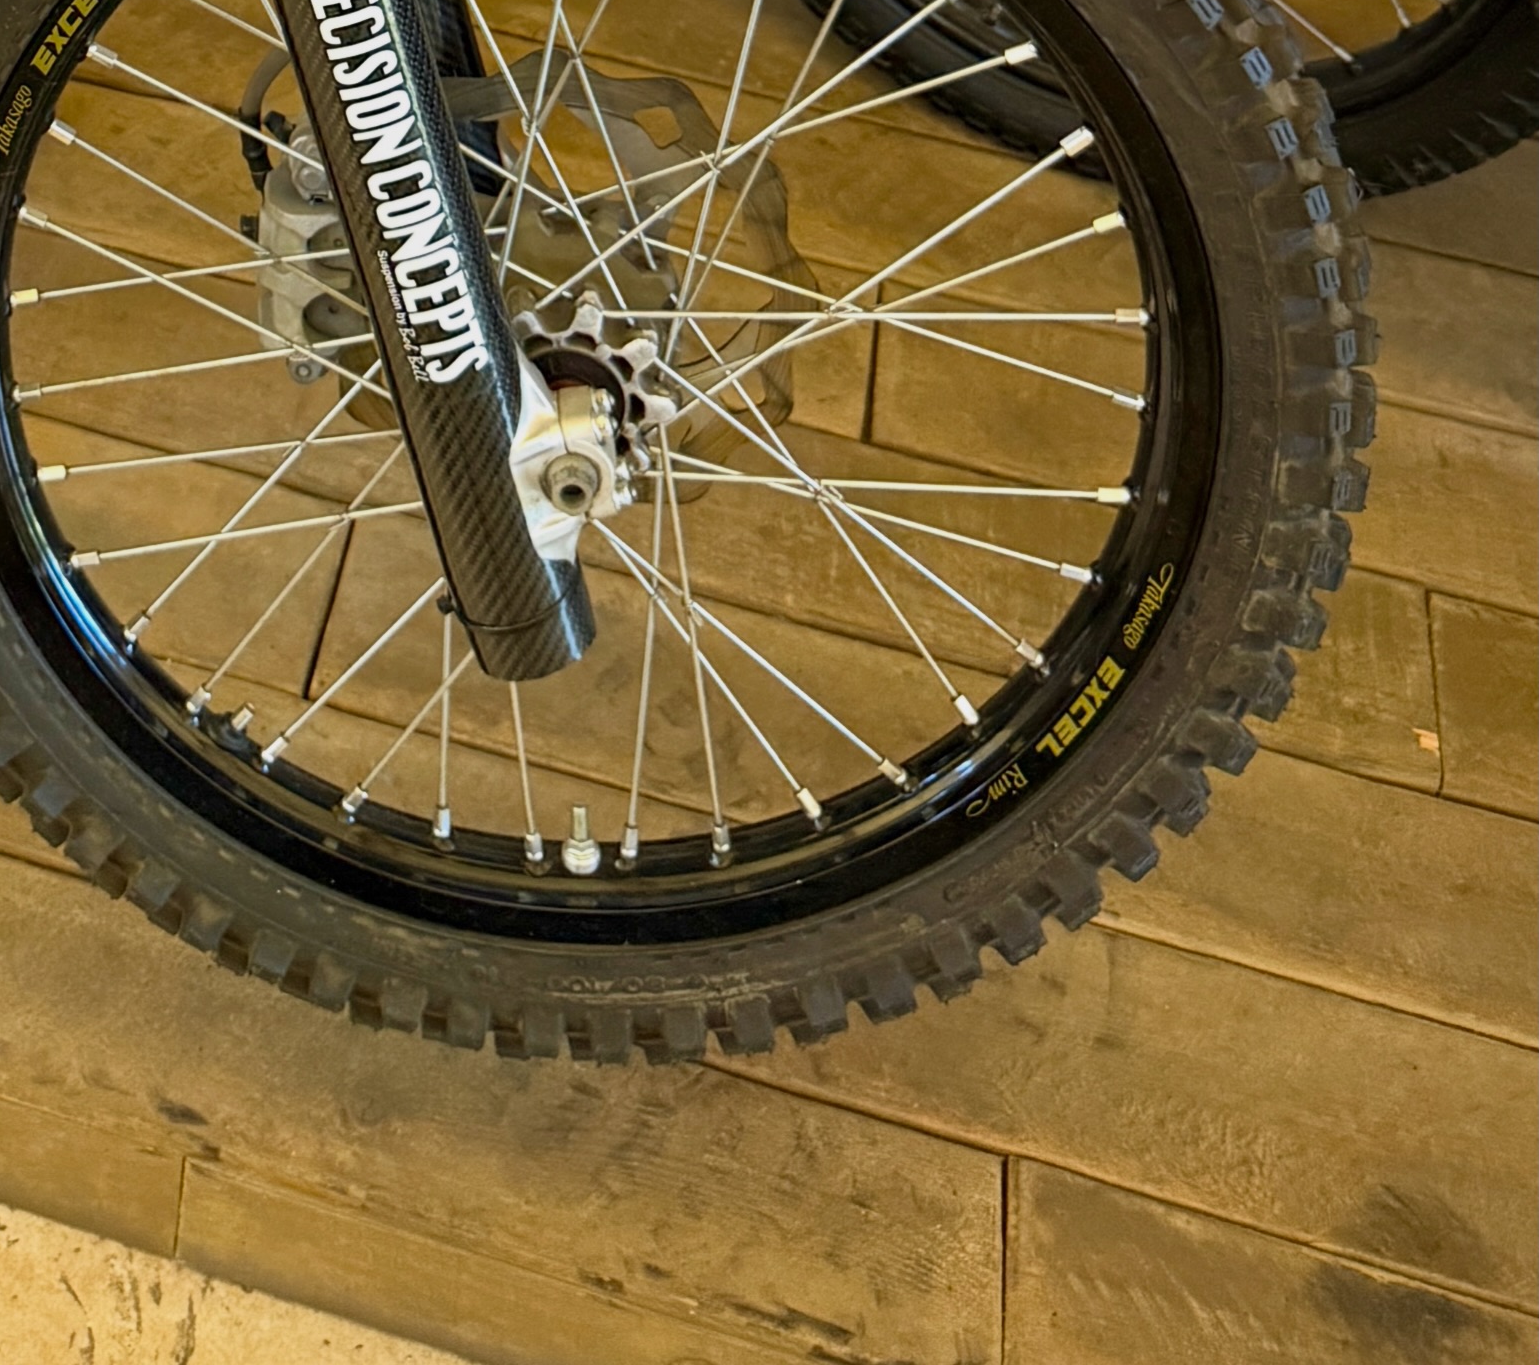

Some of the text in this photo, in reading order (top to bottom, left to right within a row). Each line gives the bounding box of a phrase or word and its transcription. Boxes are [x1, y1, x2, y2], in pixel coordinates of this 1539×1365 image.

[366, 159, 489, 385] CONCEPTS
[377, 249, 403, 310] Suspension
[965, 562, 1174, 818] Takasago EXCEL Rim
